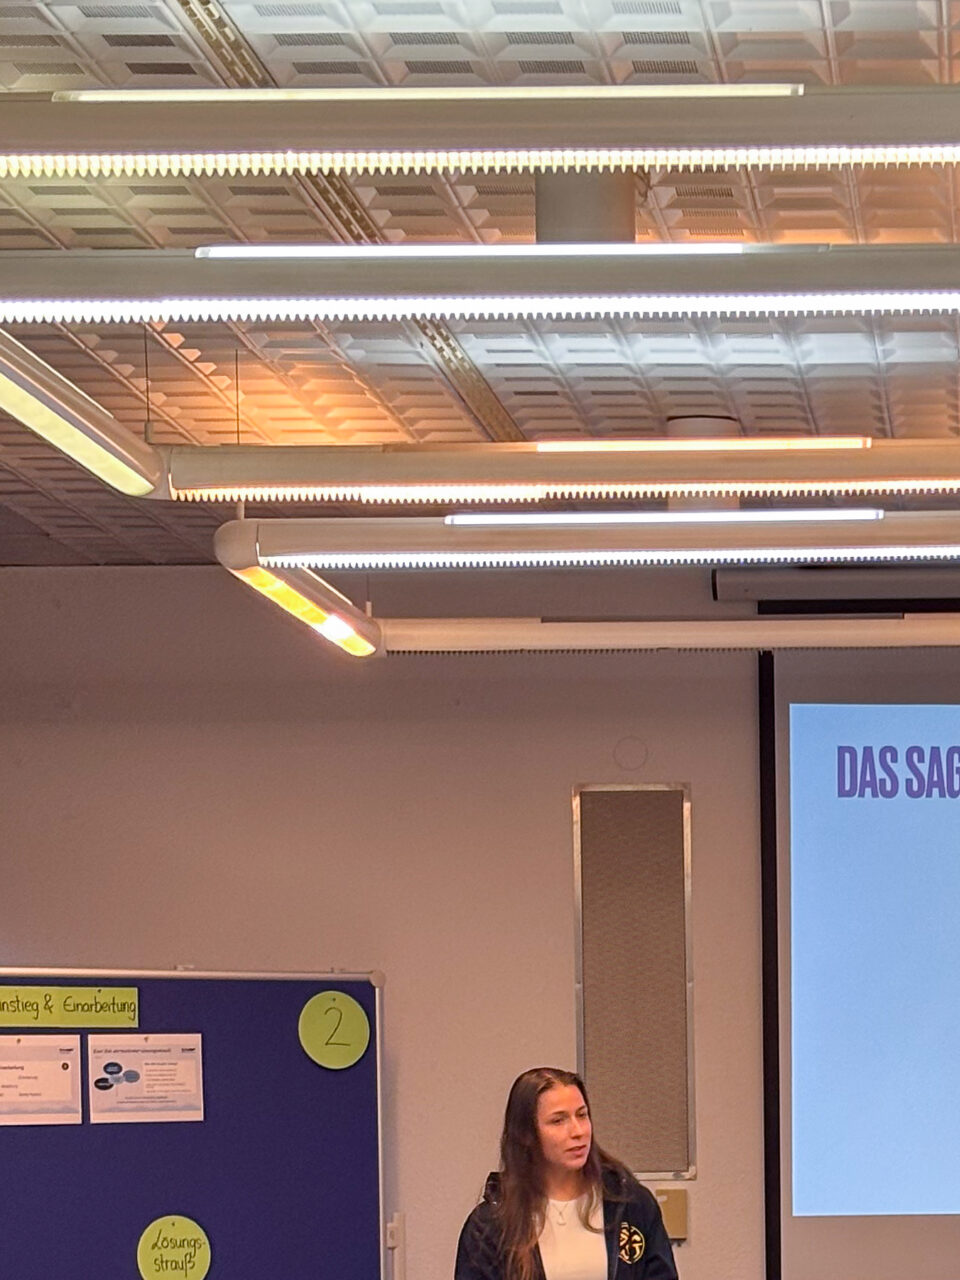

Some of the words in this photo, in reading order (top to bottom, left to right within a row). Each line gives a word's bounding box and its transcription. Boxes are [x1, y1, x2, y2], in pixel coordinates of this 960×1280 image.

[837, 746, 899, 799] DAS
[44, 993, 54, 1014] &
[63, 994, 137, 1021] Einarbeitung
[324, 1007, 352, 1047] 2
[151, 1229, 206, 1258] Lösungs-
[153, 1251, 196, 1279] strauß
